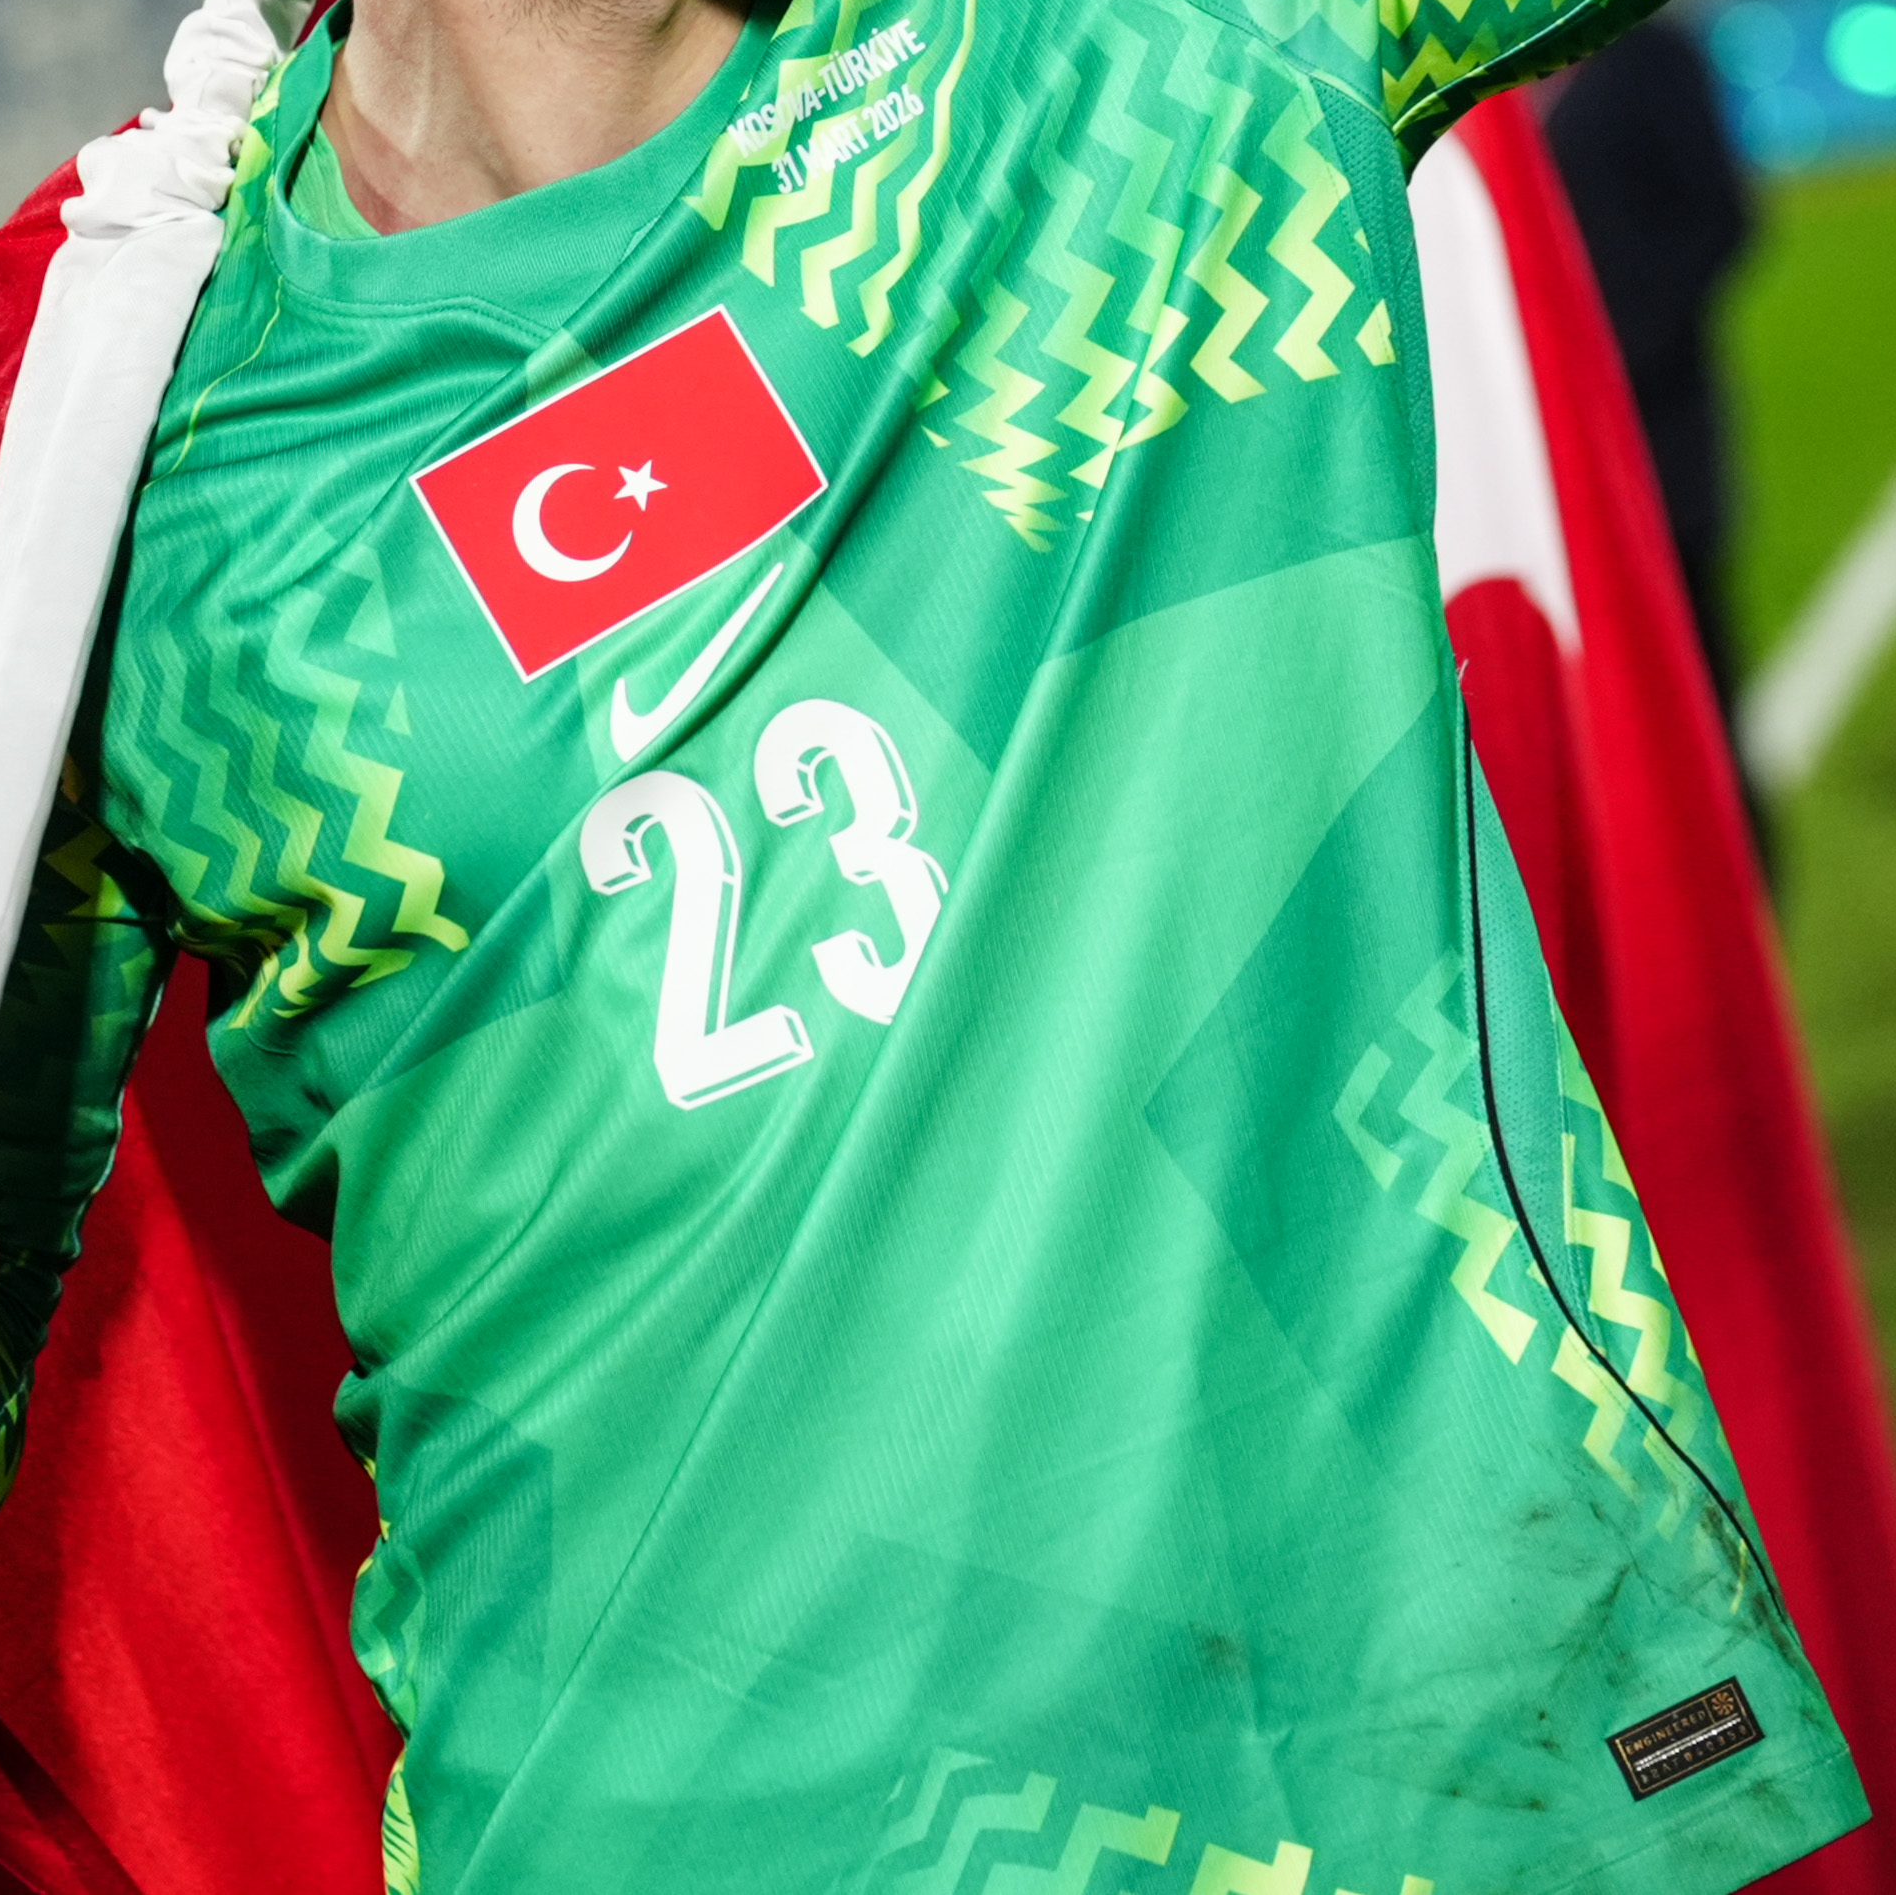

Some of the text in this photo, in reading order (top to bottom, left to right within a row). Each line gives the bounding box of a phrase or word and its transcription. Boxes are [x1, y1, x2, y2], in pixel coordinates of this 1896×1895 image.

[727, 18, 926, 158] KOSOVA-TÜRKİYE
[771, 83, 925, 195] 31 MART 2026
[579, 698, 950, 1112] 23
[1625, 1709, 1707, 1756] ENGINEERED
